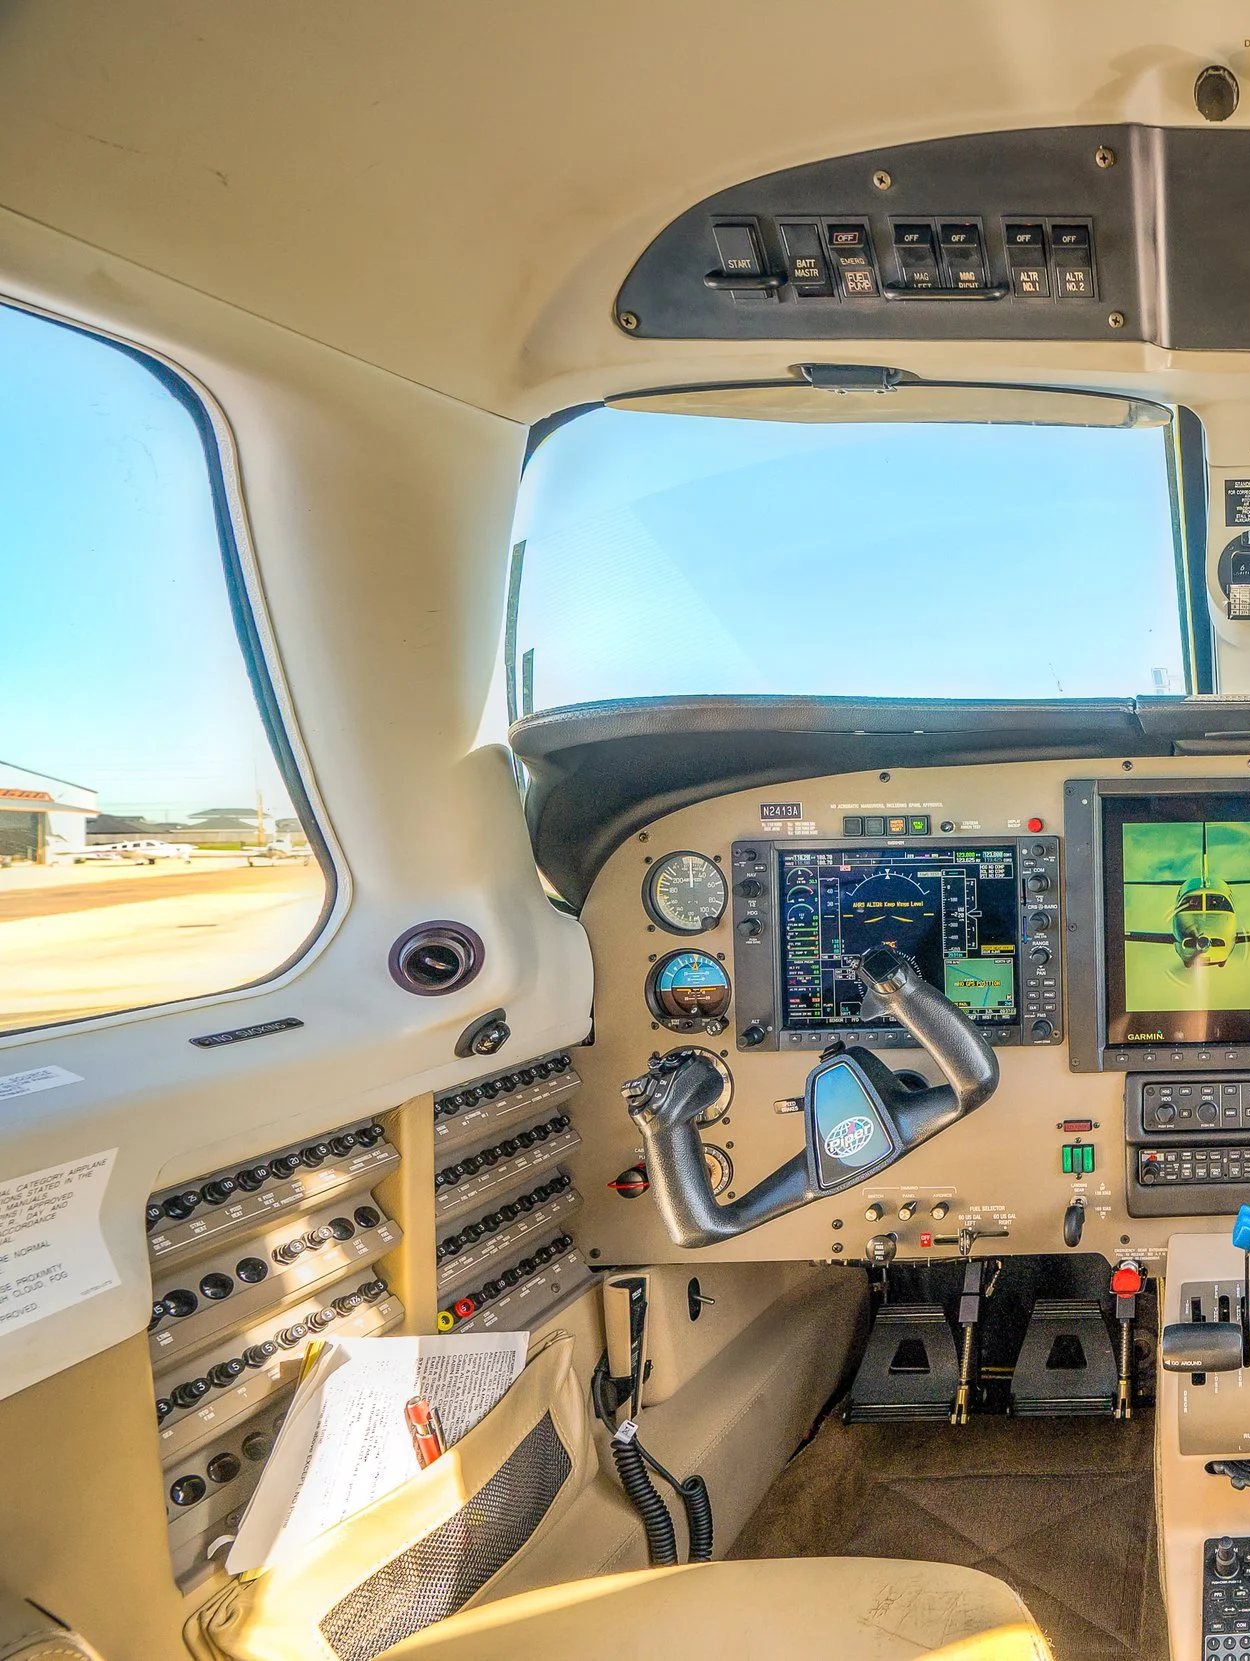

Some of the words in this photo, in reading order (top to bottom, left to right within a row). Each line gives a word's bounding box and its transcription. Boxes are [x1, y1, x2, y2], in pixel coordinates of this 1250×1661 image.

[728, 260, 751, 268] START
[848, 274, 868, 282] FUEL
[960, 272, 975, 280] MAG
[1020, 272, 1038, 280] ALTR
[1066, 272, 1084, 280] ALTR
[849, 282, 872, 290] PUMP
[763, 807, 798, 816] N2413A
[213, 1034, 233, 1042] NO
[829, 1123, 870, 1152] Piper
[437, 1356, 446, 1382] Alternate
[442, 1356, 452, 1383] Induction
[449, 1355, 457, 1375] CABIN
[444, 1376, 453, 1399] PRESS
[450, 1376, 459, 1398] PRESS
[466, 1370, 475, 1395] Controls
[445, 1400, 454, 1421] Control
